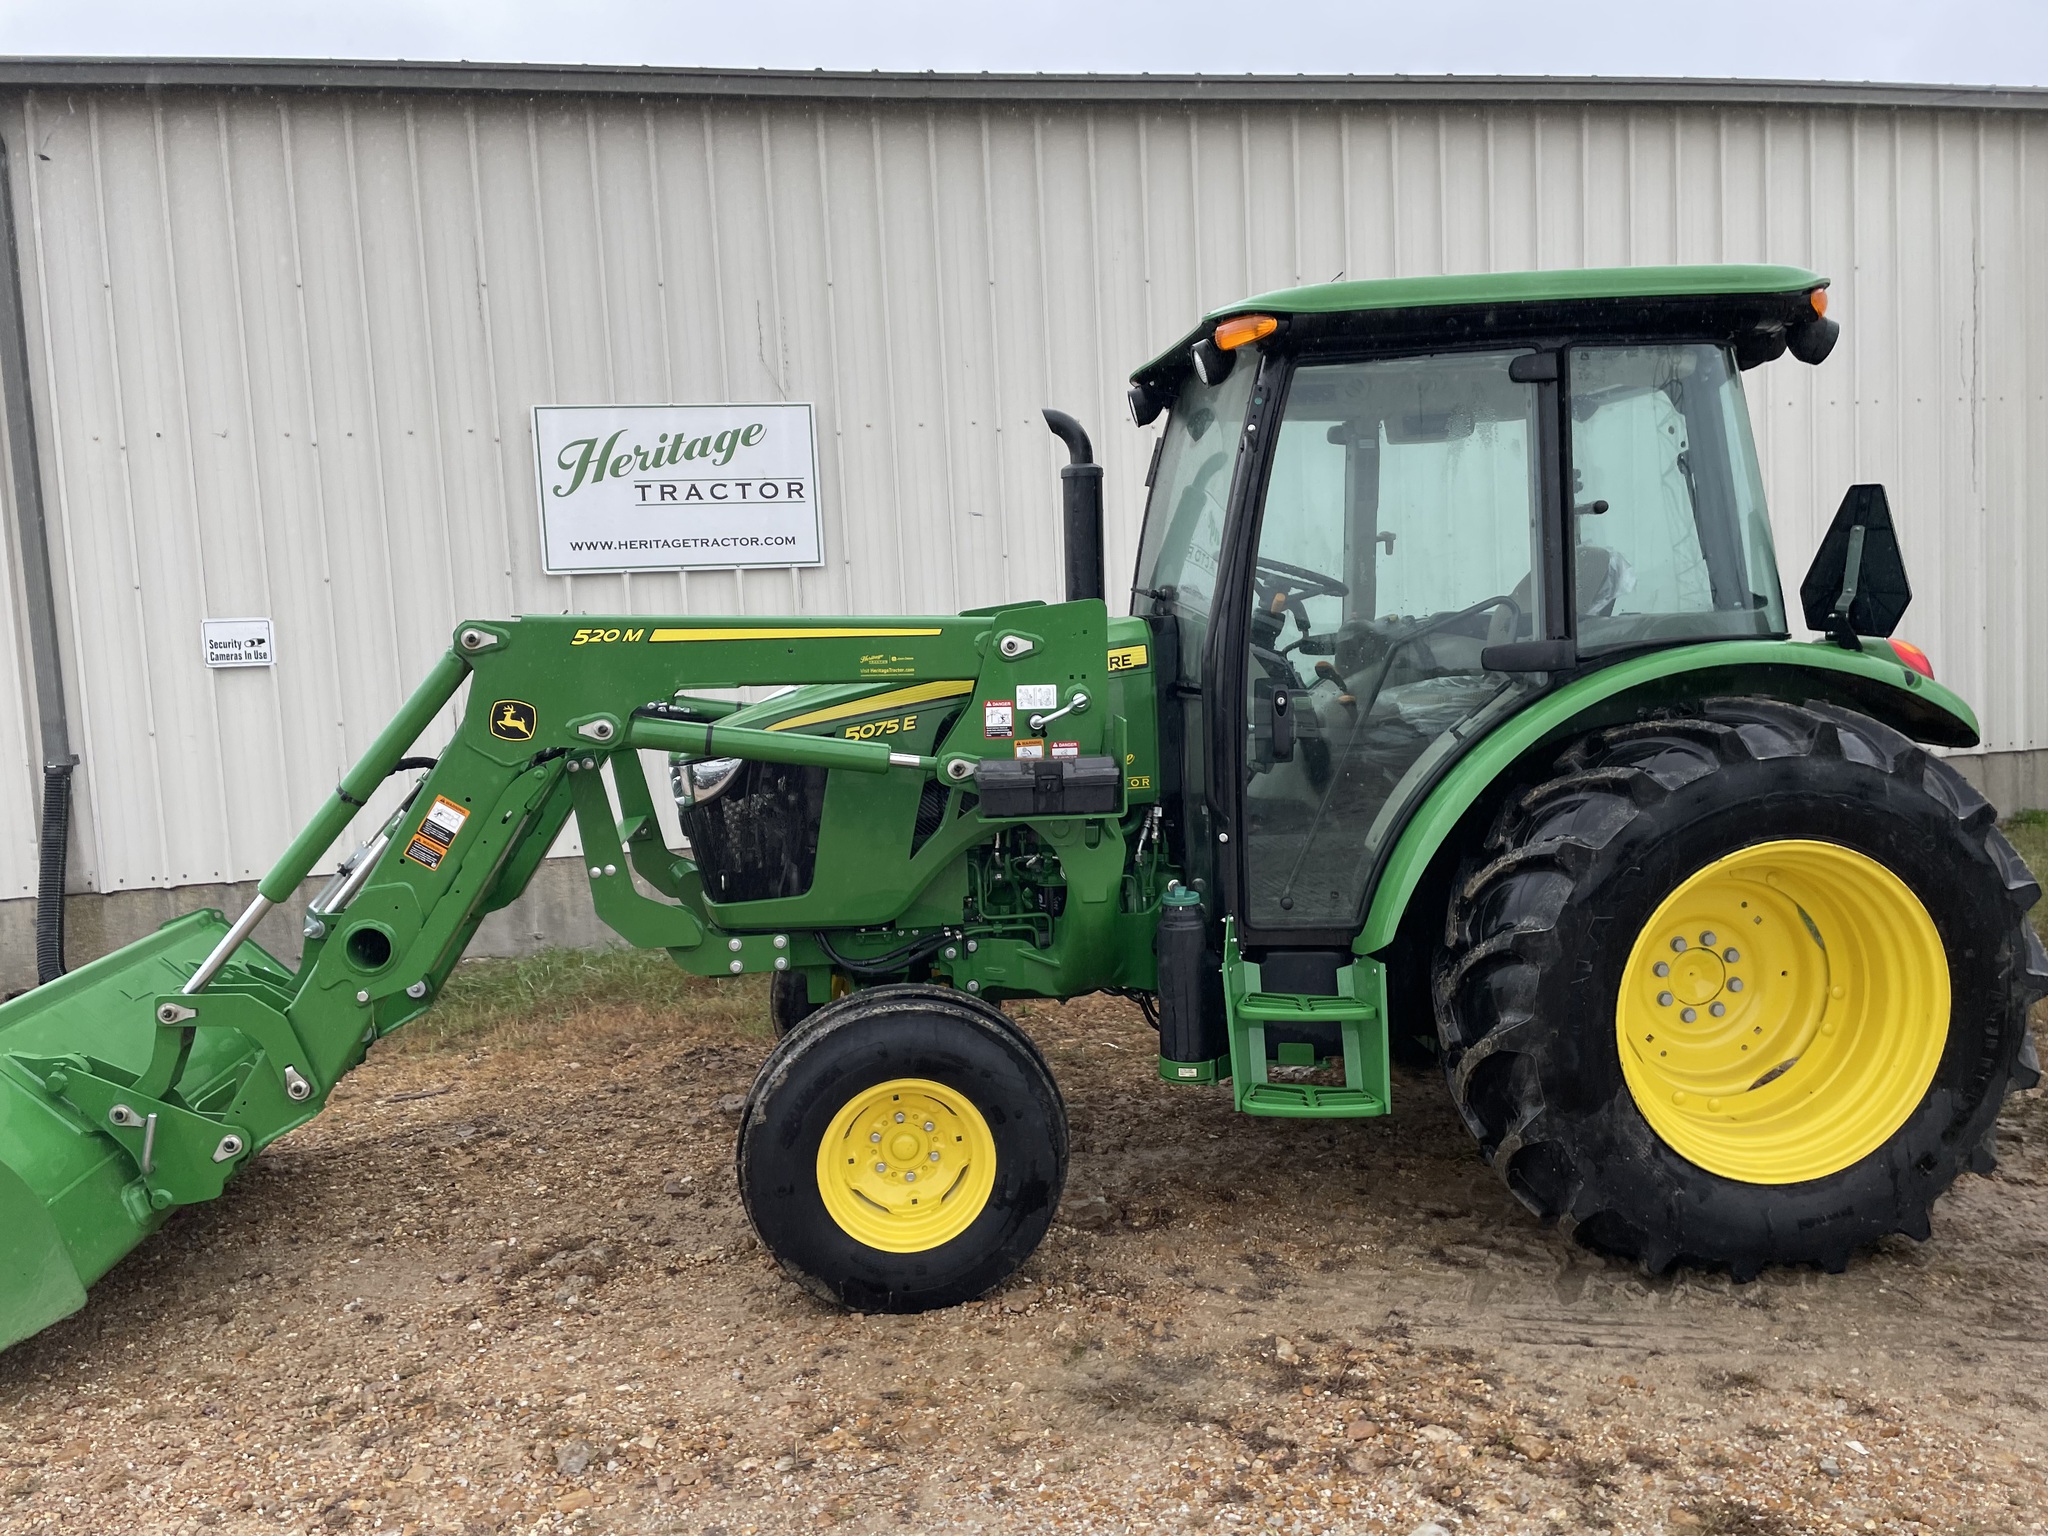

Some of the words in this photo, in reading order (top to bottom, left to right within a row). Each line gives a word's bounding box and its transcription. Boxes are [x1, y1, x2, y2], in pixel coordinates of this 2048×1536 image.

[553, 423, 767, 497] Heritage
[635, 481, 805, 502] TRACTOR
[570, 536, 796, 551] WWW.HERITAGETRACTOR.COM
[209, 638, 242, 650] Security
[570, 628, 621, 646] 520
[622, 628, 645, 642] M
[210, 651, 243, 661] Cameras
[244, 650, 253, 660] In
[254, 650, 268, 660] Use
[845, 718, 900, 741] 5075
[902, 715, 917, 731] E
